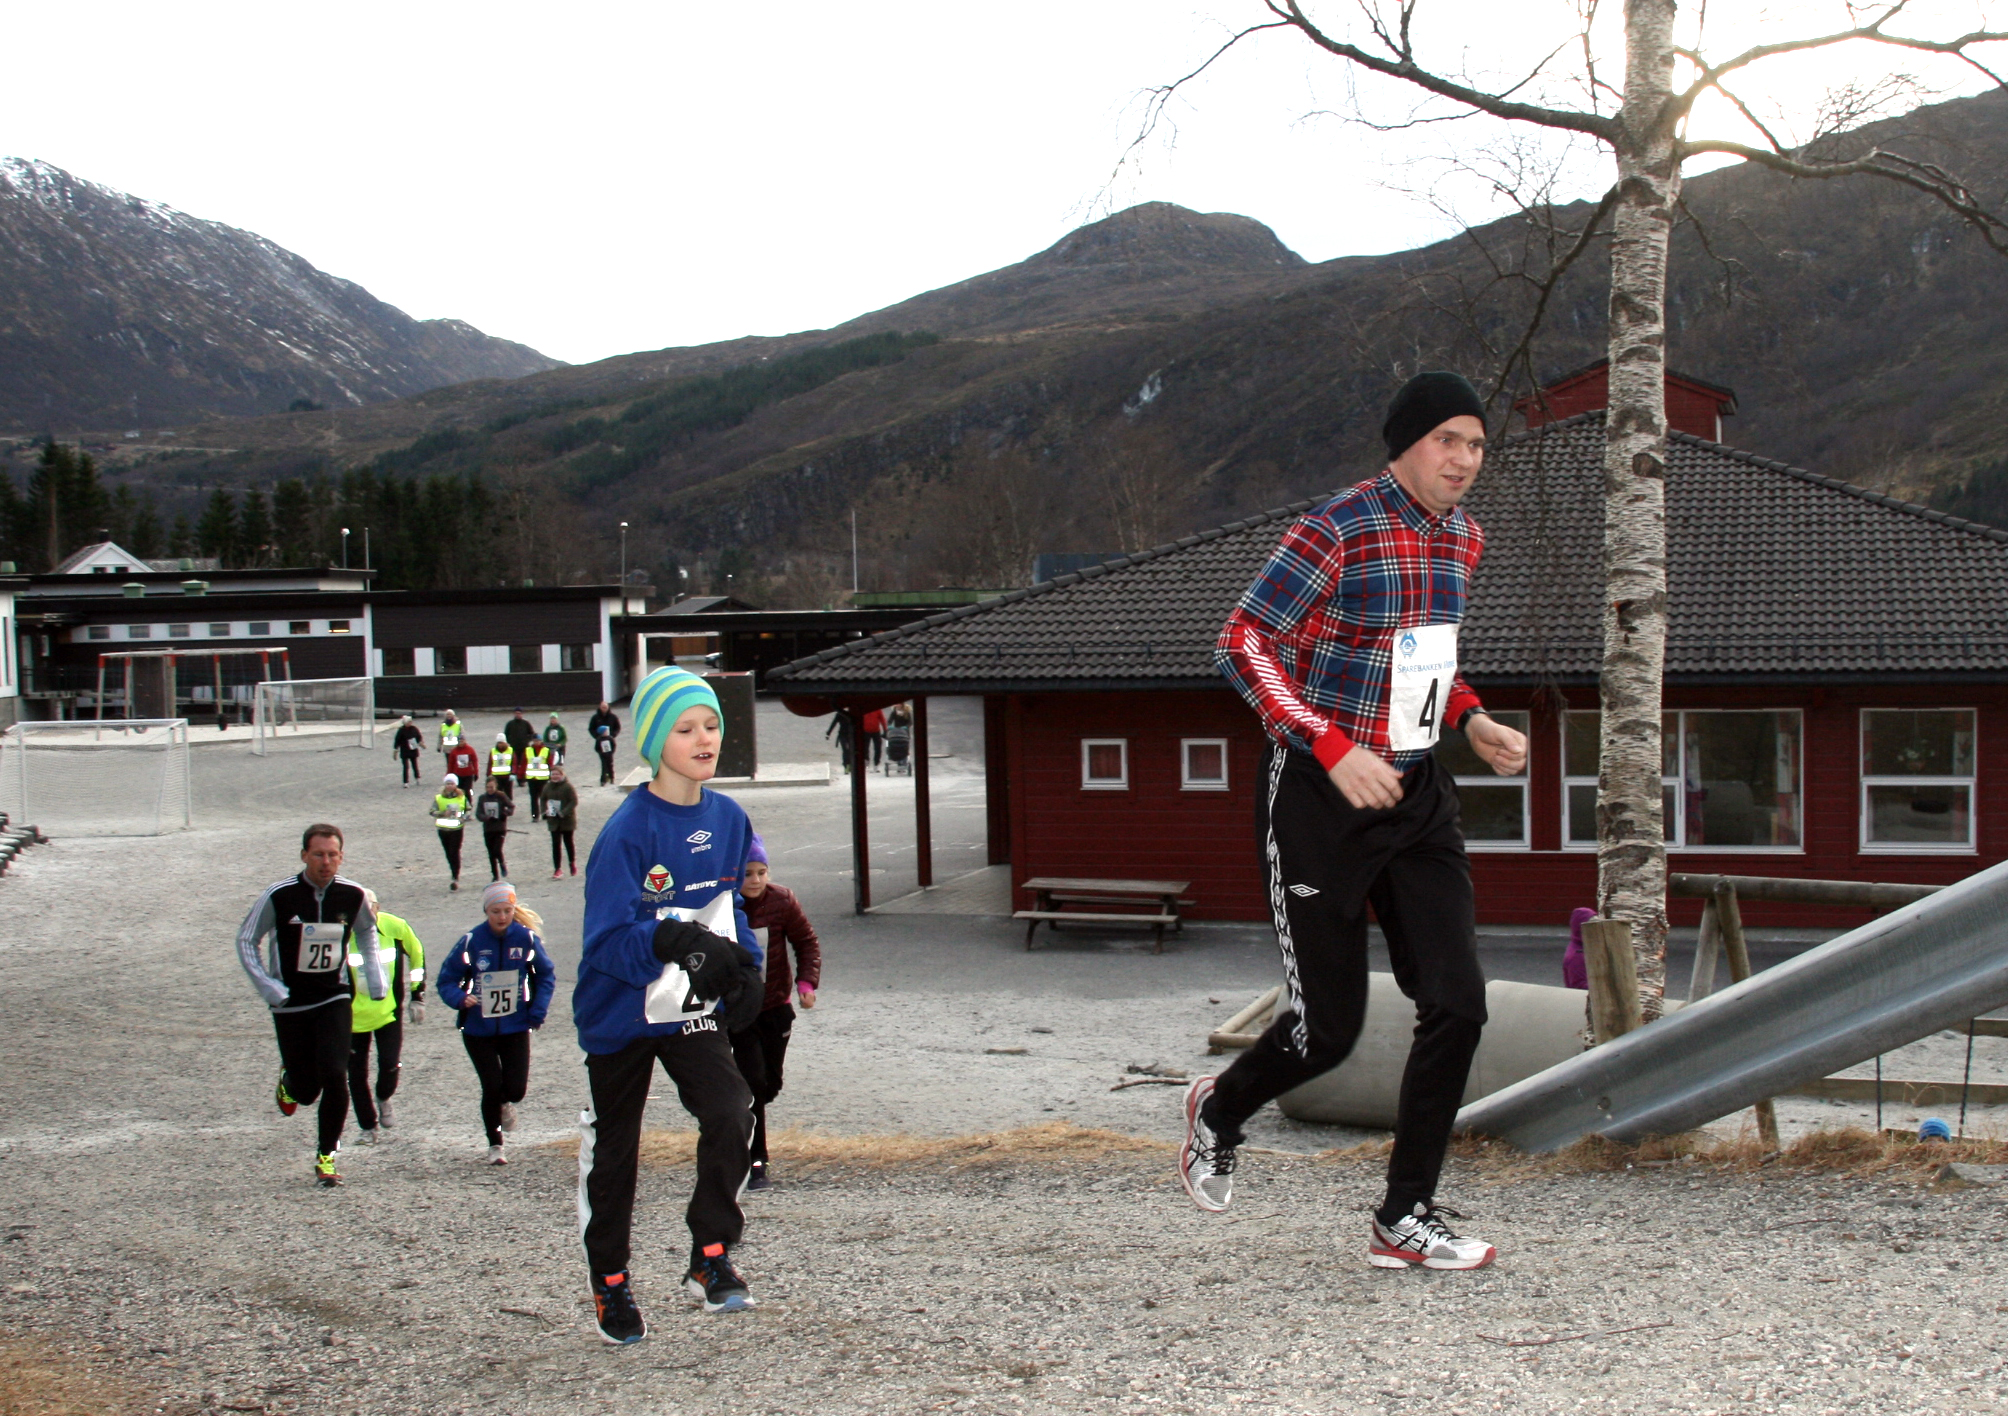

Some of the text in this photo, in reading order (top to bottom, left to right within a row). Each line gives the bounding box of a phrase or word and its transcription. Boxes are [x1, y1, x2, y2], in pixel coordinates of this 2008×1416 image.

[1419, 678, 1438, 739] 4
[691, 844, 711, 853] umbro
[641, 891, 676, 902] SPORT
[308, 943, 333, 970] 26
[490, 989, 512, 1014] 25
[682, 1017, 717, 1035] CLUB
